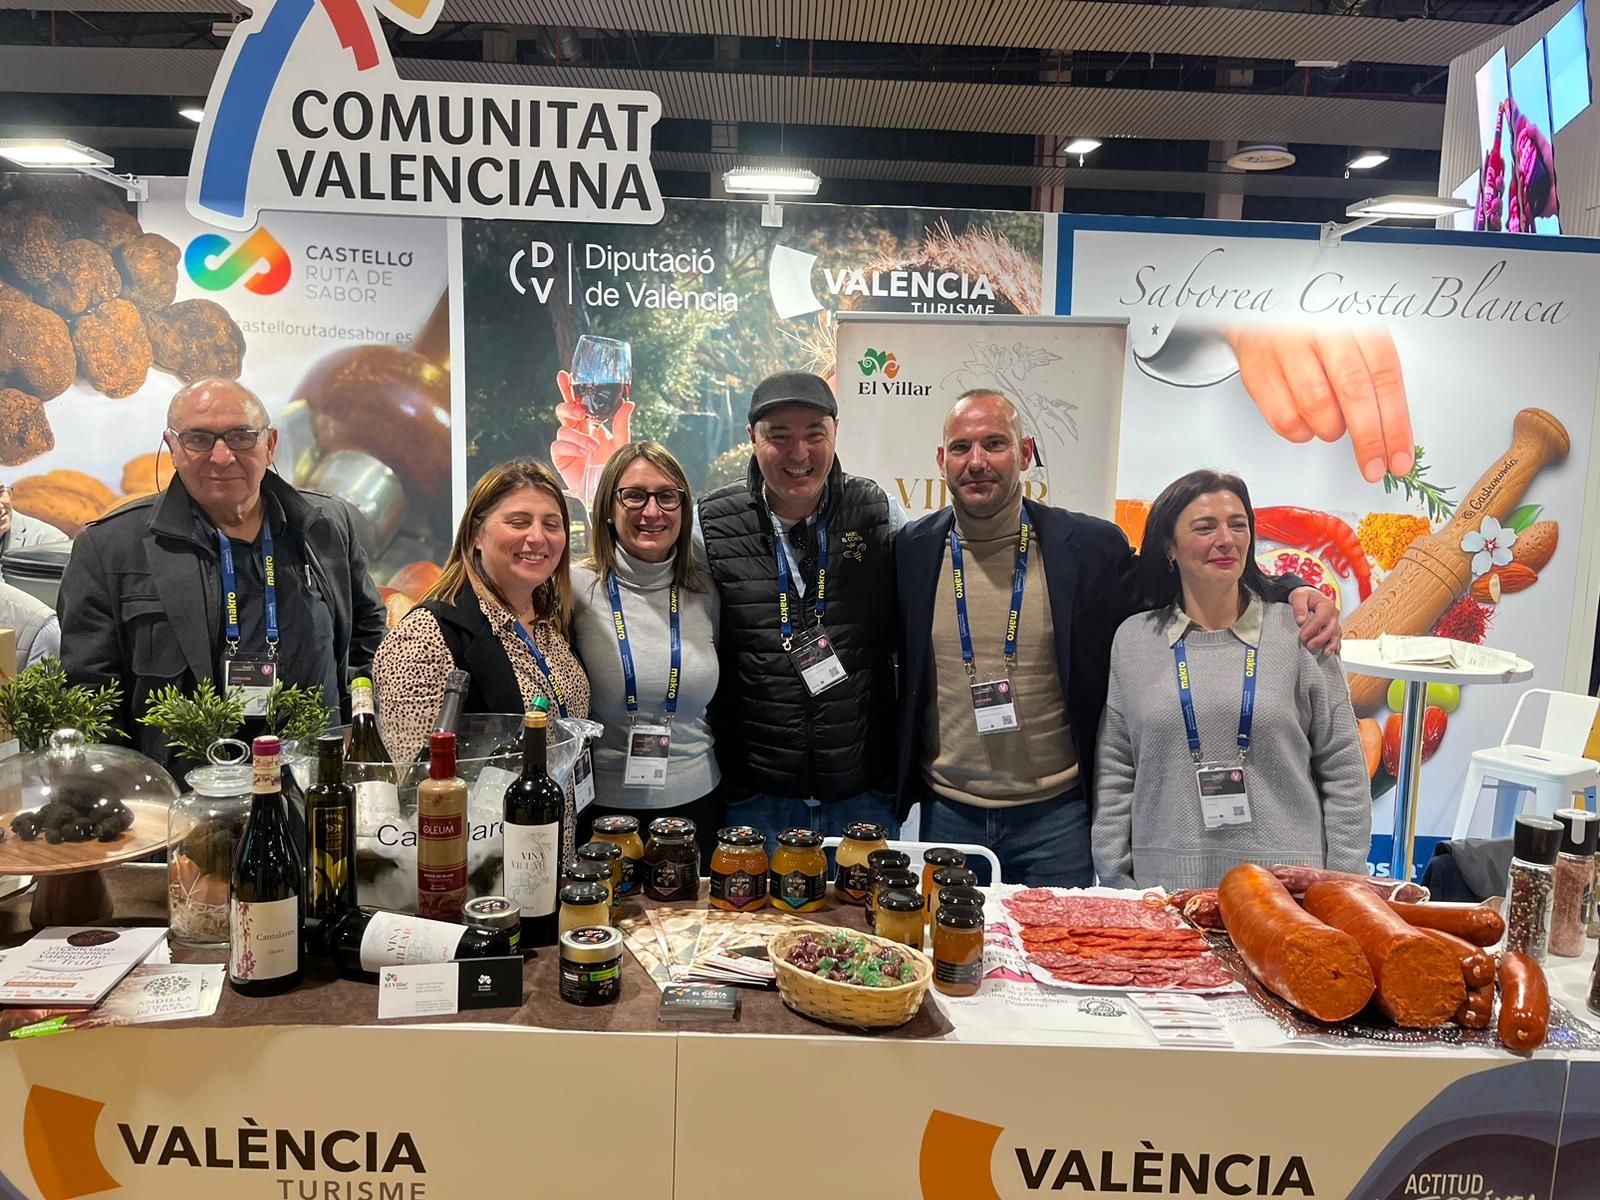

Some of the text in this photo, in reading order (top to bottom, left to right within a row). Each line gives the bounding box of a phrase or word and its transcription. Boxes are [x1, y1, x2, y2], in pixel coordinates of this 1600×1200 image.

[291, 89, 649, 153] COMUNITAT
[276, 148, 653, 211] VALENCIANA
[585, 243, 716, 275] Diputació
[305, 265, 393, 287] RUTA DE
[823, 264, 996, 301] VALÈNCIA
[1119, 248, 1277, 313] Saborea
[305, 284, 377, 303] SABOR
[584, 280, 739, 312] de València
[911, 301, 995, 315] TURISME
[858, 381, 932, 396] El Villar
[1019, 523, 1028, 553] makro
[265, 555, 275, 586] makro
[818, 569, 826, 599] makro
[954, 569, 963, 599] makro
[228, 592, 237, 624] makro
[780, 593, 789, 623] makro
[613, 611, 626, 640] makro
[1007, 610, 1018, 641] makro
[1178, 661, 1189, 689] makro
[1246, 649, 1255, 677] makro
[668, 668, 678, 699] makro
[256, 929, 294, 941] Cantalares
[117, 1116, 426, 1174] VALÈNCIA
[1014, 1140, 1315, 1197] VALÈNCIA
[276, 1179, 426, 1200] TURISME
[1404, 1173, 1484, 1196] ACTITUD
